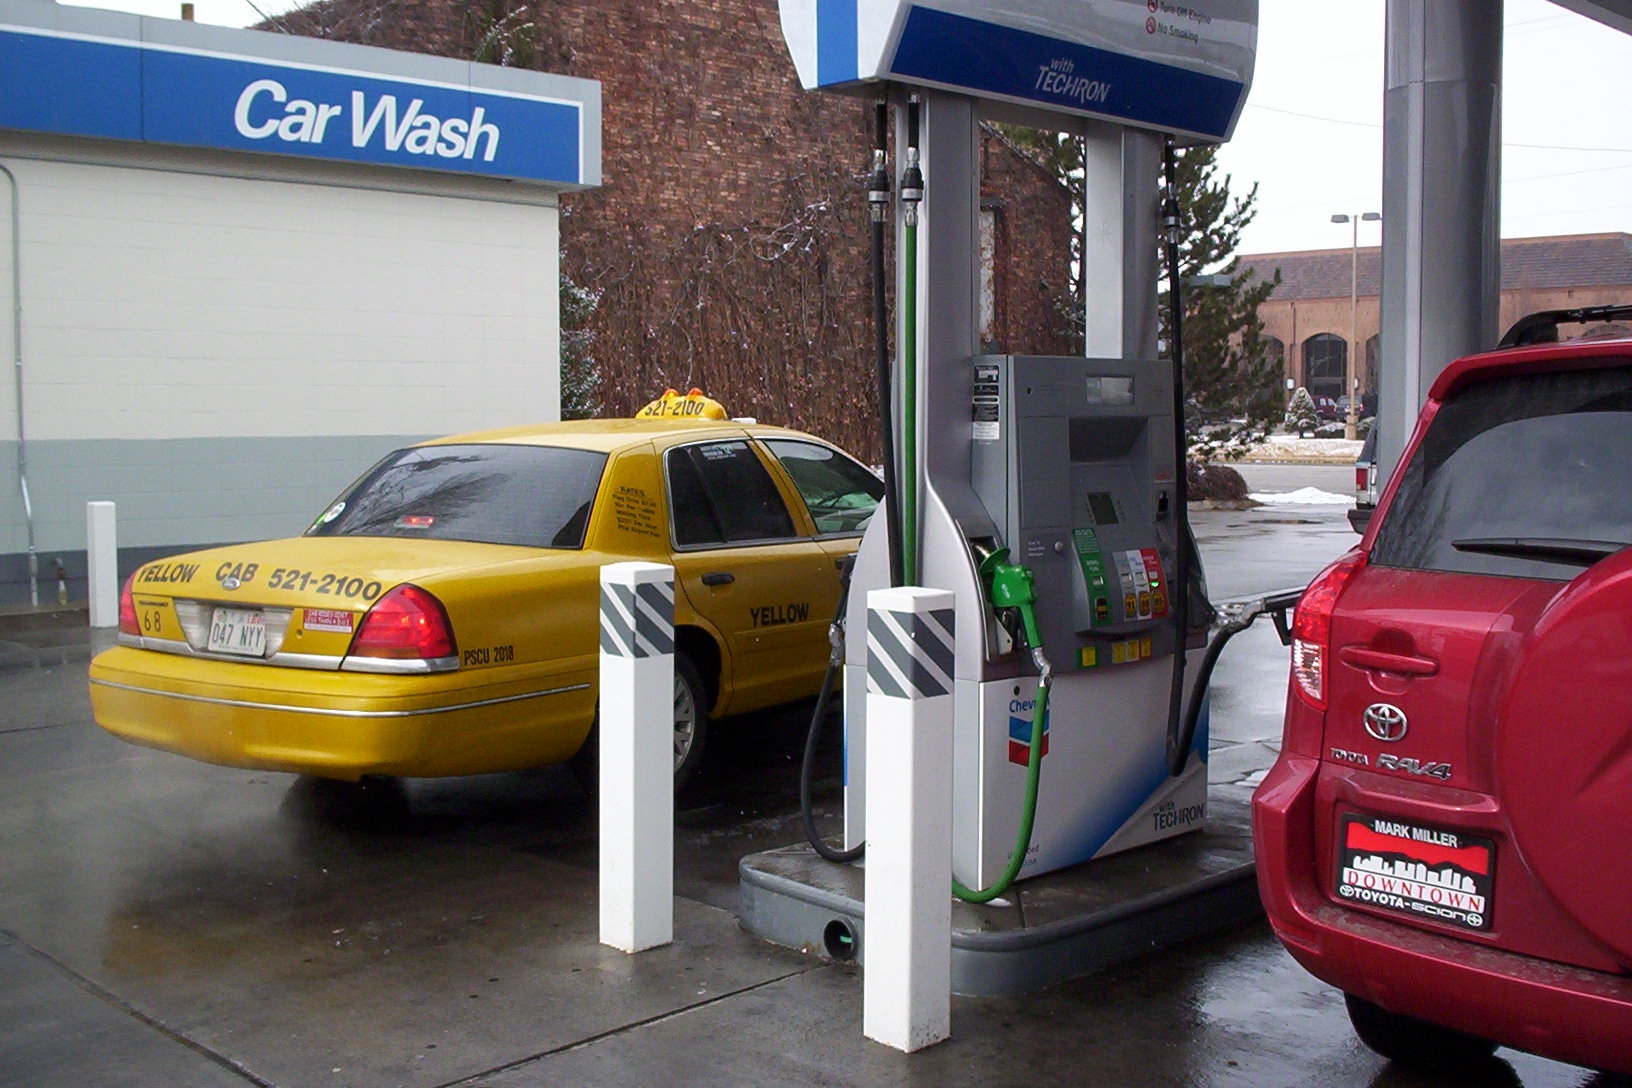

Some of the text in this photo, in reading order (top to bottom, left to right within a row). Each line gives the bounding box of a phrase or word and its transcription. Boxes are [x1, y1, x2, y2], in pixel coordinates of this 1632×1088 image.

[1158, 22, 1198, 44] No Smoking
[1051, 57, 1074, 73] with
[1035, 65, 1111, 104] TECHRON
[234, 79, 500, 162] Car Wash
[645, 399, 705, 417] 521-2100
[138, 561, 382, 601] YELLOW CAB 521-2100
[144, 610, 162, 633] 68
[750, 602, 810, 628] YELLOW
[211, 623, 264, 648] 047 NYY
[464, 645, 514, 666] PSCU 2018
[1330, 748, 1452, 780] TOYOTA RAV4
[1153, 803, 1204, 831] TECHRON
[1375, 820, 1458, 848] MARK MILLER
[1347, 870, 1481, 912] DOWNTOWN
